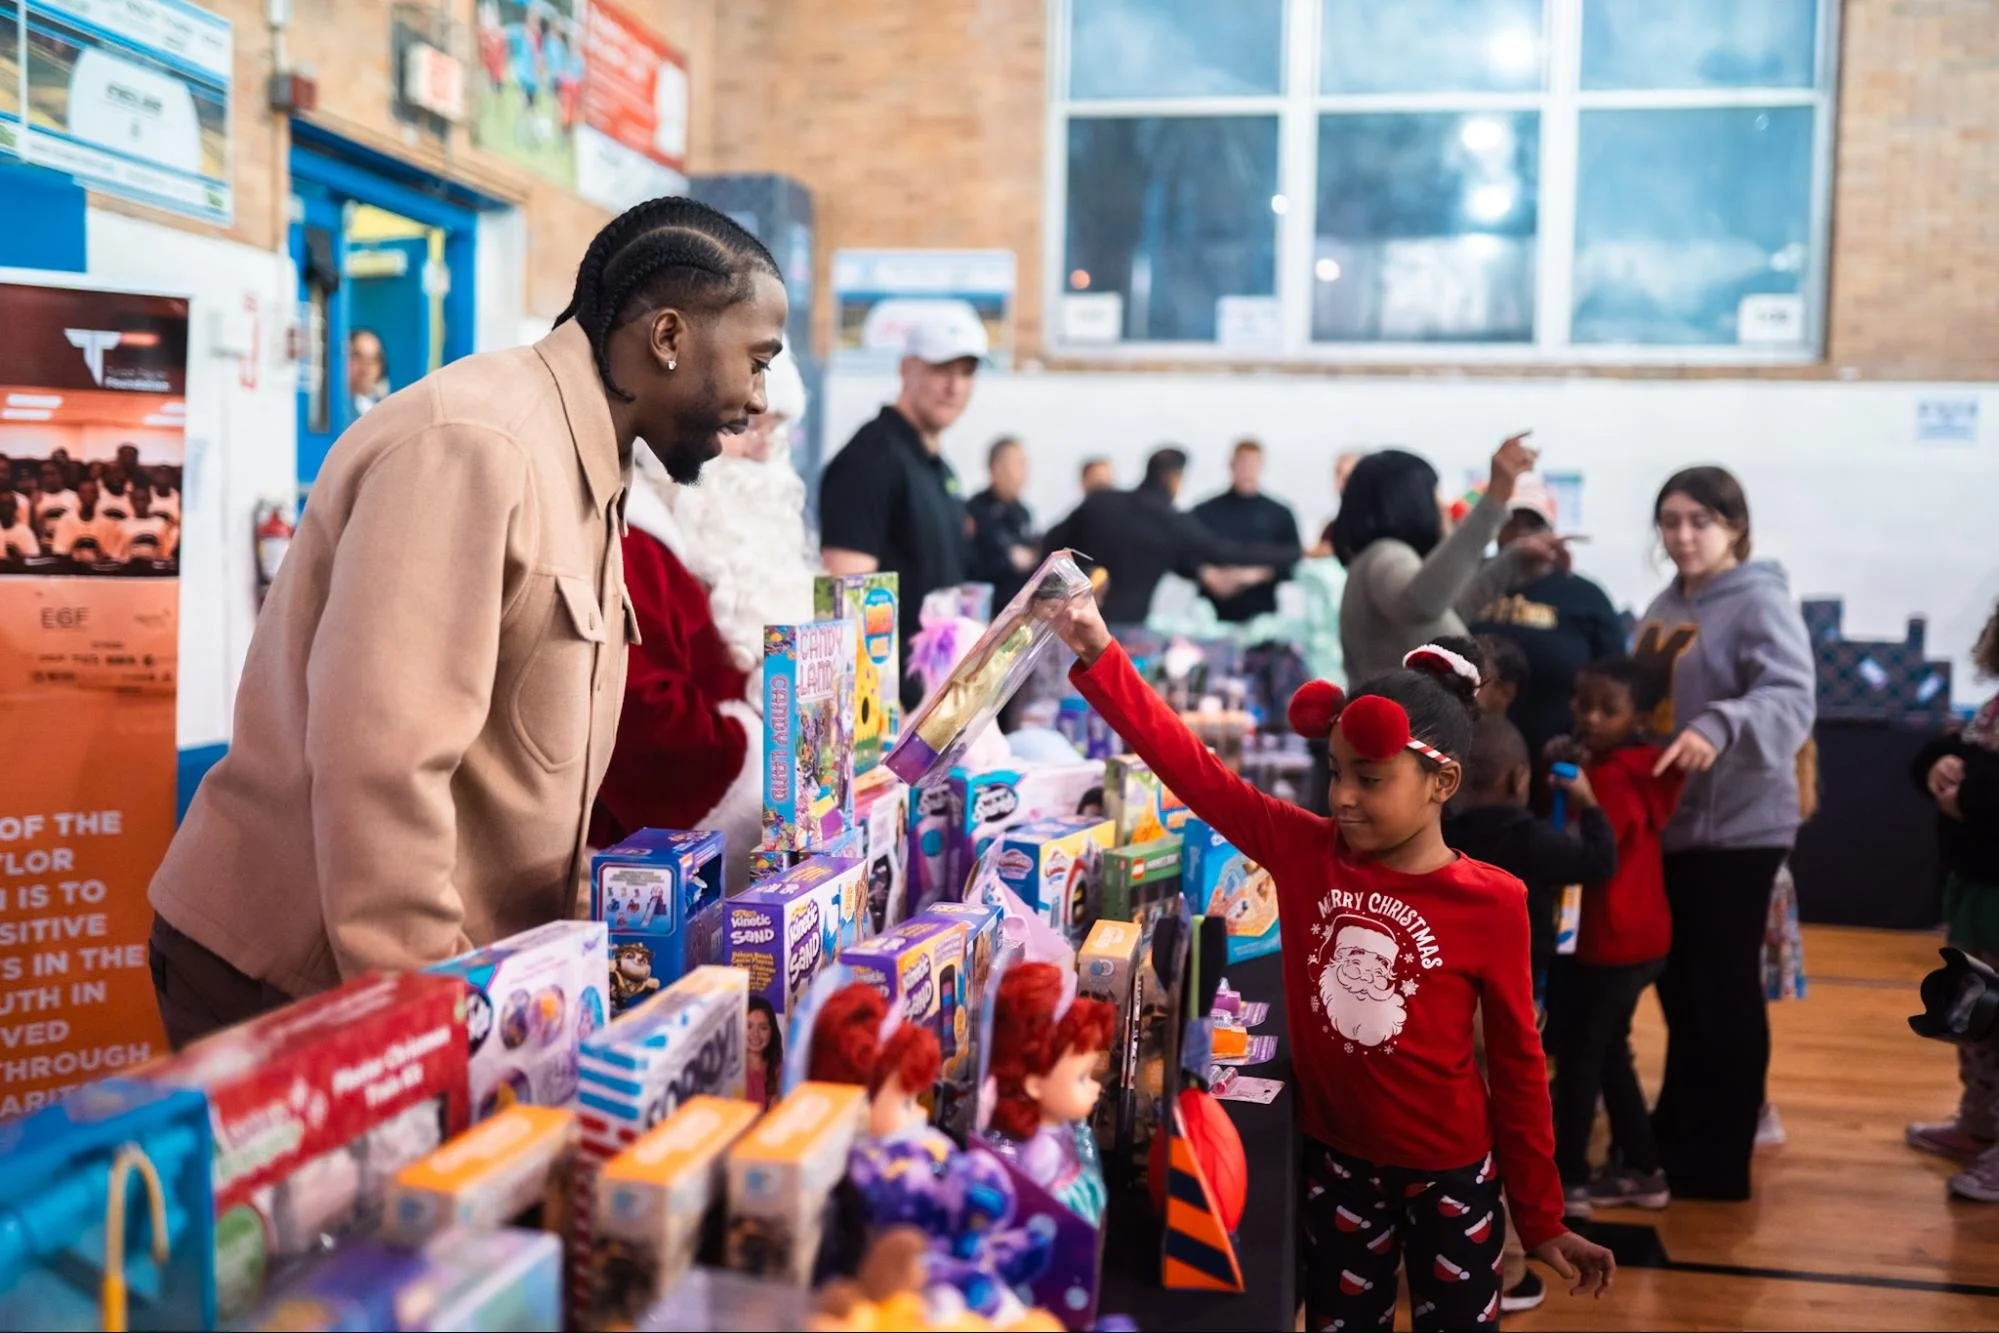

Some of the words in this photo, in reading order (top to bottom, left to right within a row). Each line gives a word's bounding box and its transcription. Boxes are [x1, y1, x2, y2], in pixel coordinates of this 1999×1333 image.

[0, 814, 44, 841] OF
[53, 810, 123, 836] THE
[0, 847, 75, 876] LOR
[17, 884, 50, 910] IS
[58, 878, 107, 905] TO
[1368, 892, 1444, 970] CHRISTMAS
[33, 951, 69, 977] IN
[79, 944, 146, 971] THE
[72, 981, 108, 1006] IN
[0, 1020, 70, 1048] VED
